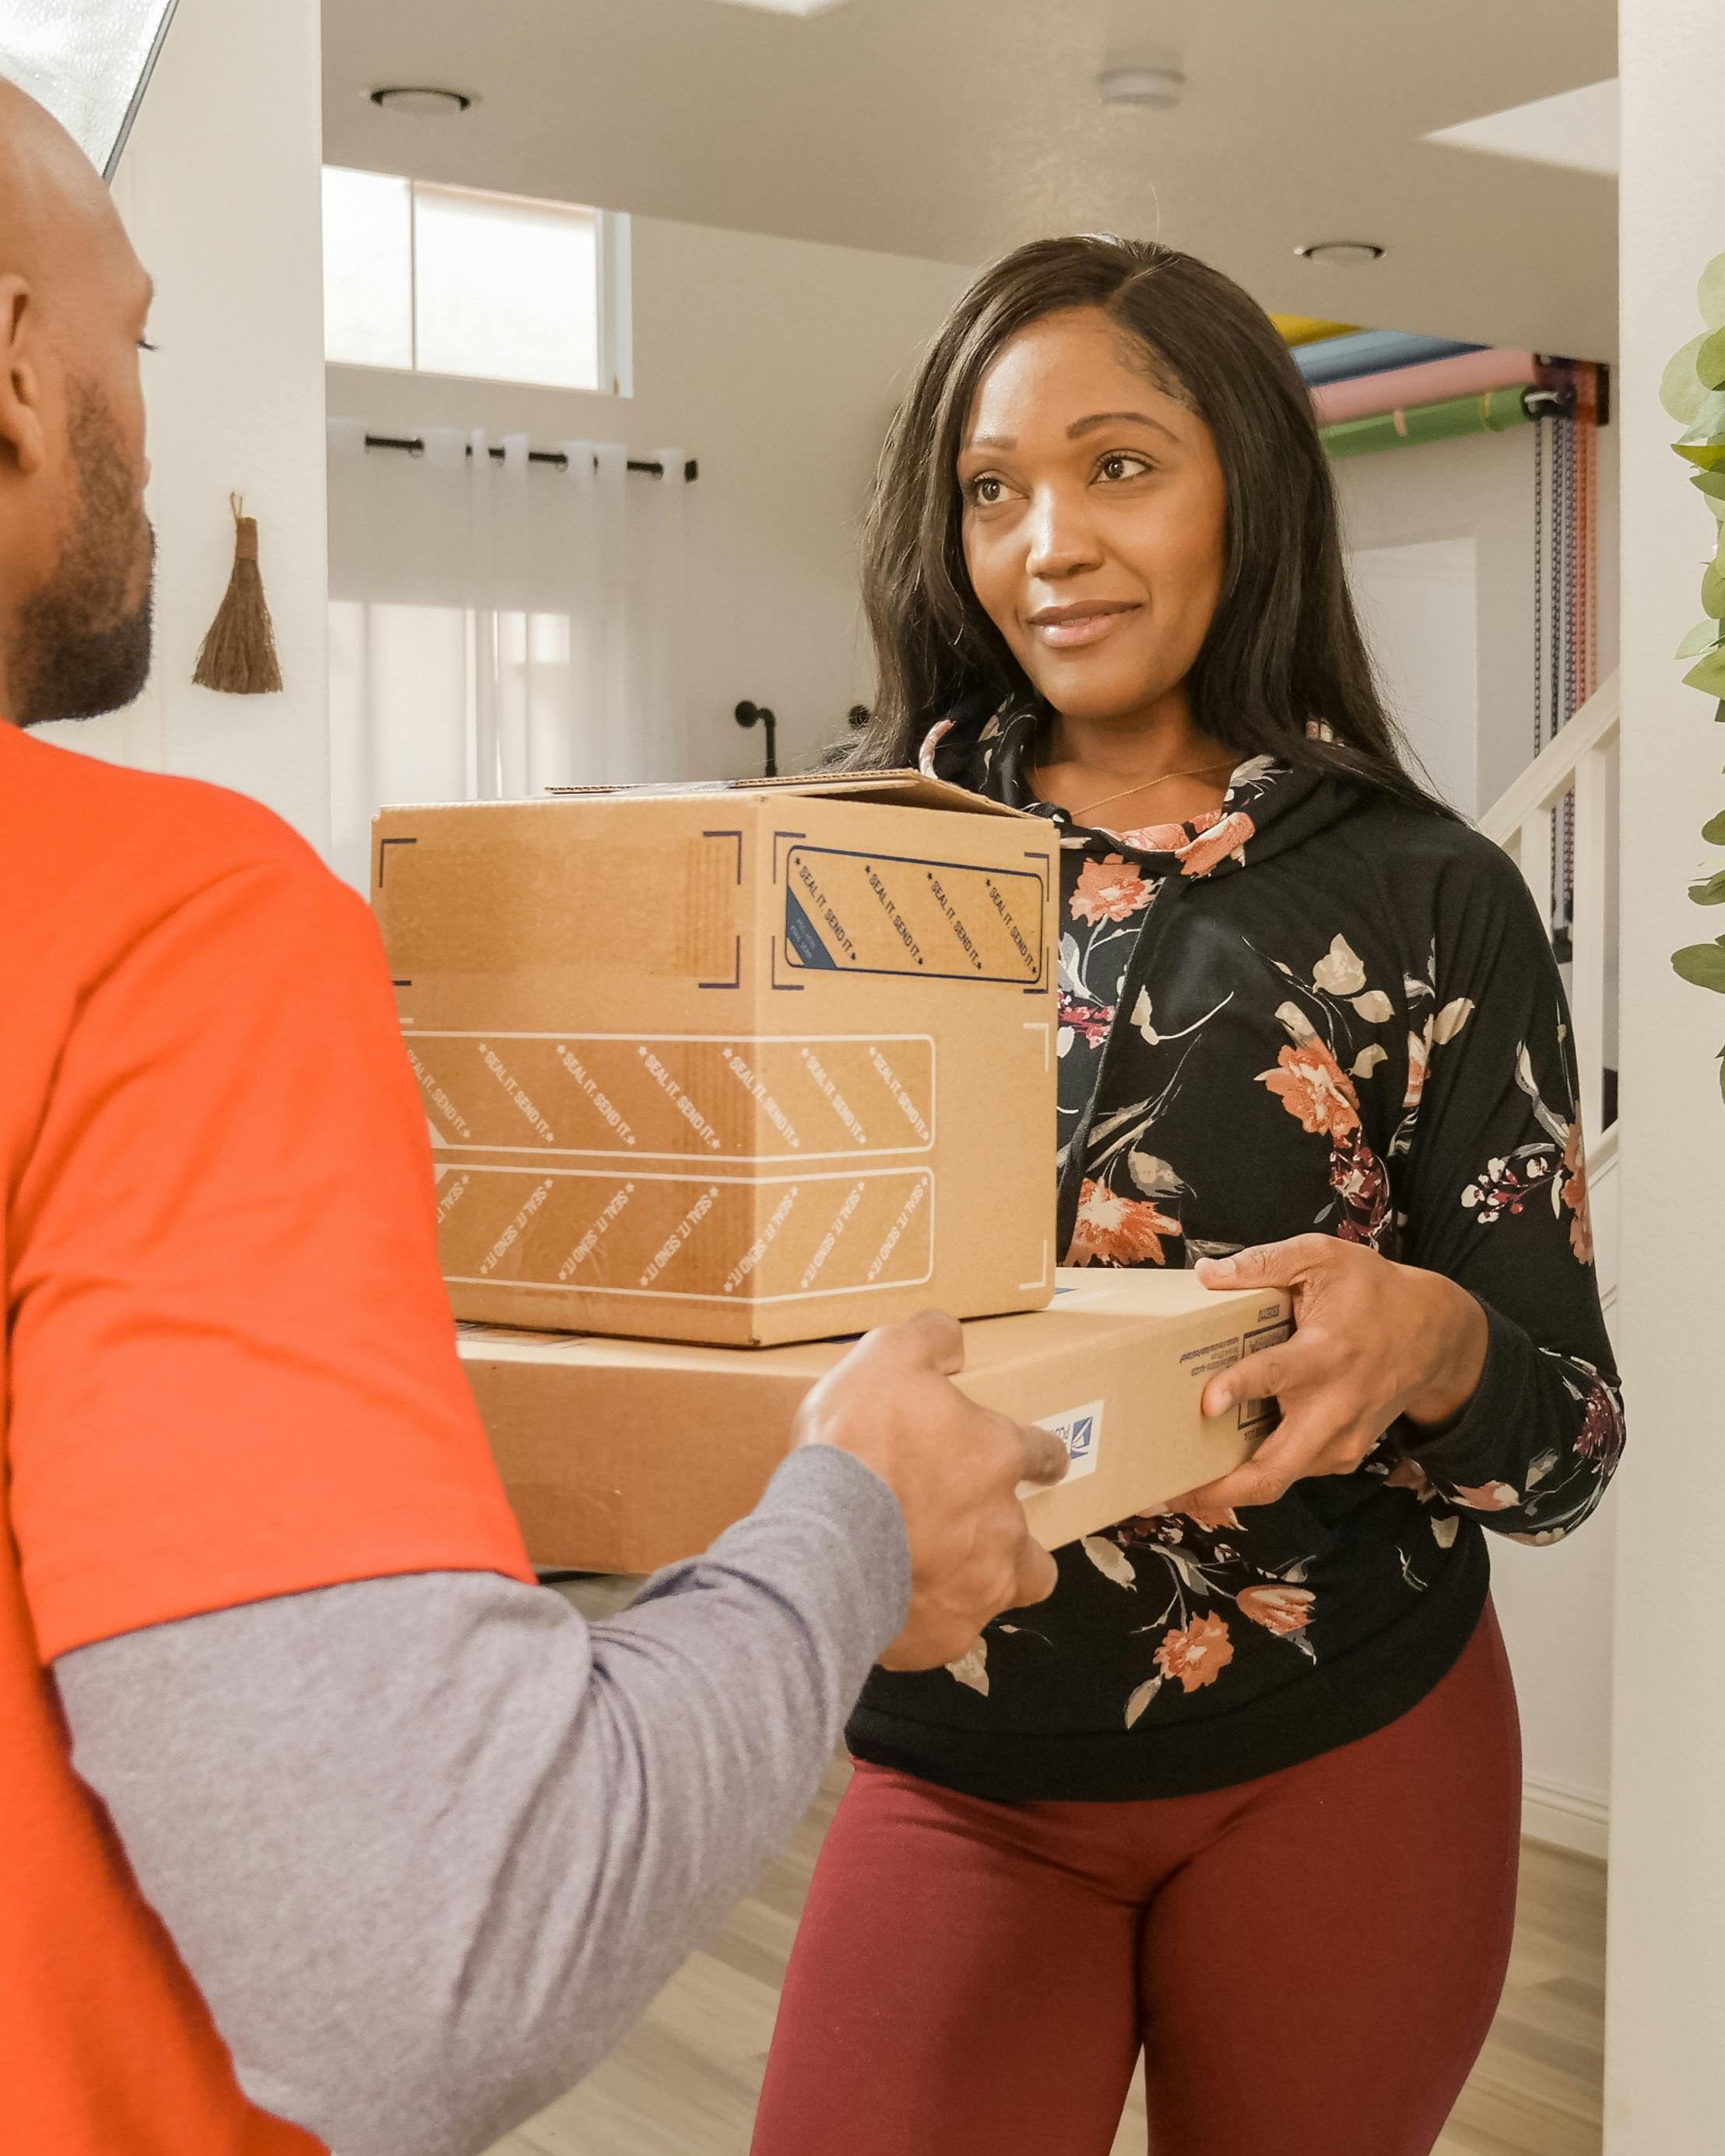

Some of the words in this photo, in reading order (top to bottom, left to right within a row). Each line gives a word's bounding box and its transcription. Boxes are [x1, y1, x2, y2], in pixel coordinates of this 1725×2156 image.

[799, 866, 818, 897] SEAL
[824, 908, 845, 941] SEND
[870, 873, 887, 904] SEAL
[894, 915, 913, 946] SEND
[932, 880, 948, 911] SEAL
[954, 921, 971, 951] SEND
[990, 887, 1006, 916] SEAL
[1010, 926, 1028, 956] SEND
[485, 1051, 507, 1082] SEAL
[563, 1052, 585, 1084] SEAL
[645, 1055, 669, 1087] SEAL
[730, 1056, 755, 1090] SEAL
[806, 1055, 826, 1087] SEAL
[874, 1054, 892, 1084] SEAL
[440, 1182, 464, 1210] SEAL
[523, 1186, 547, 1214] SEAL
[603, 1191, 628, 1219] SEAL
[687, 1194, 712, 1224] SEAL
[771, 1195, 792, 1225] SEAL
[839, 1189, 859, 1219] SEAL
[905, 1185, 923, 1213] SEAL
